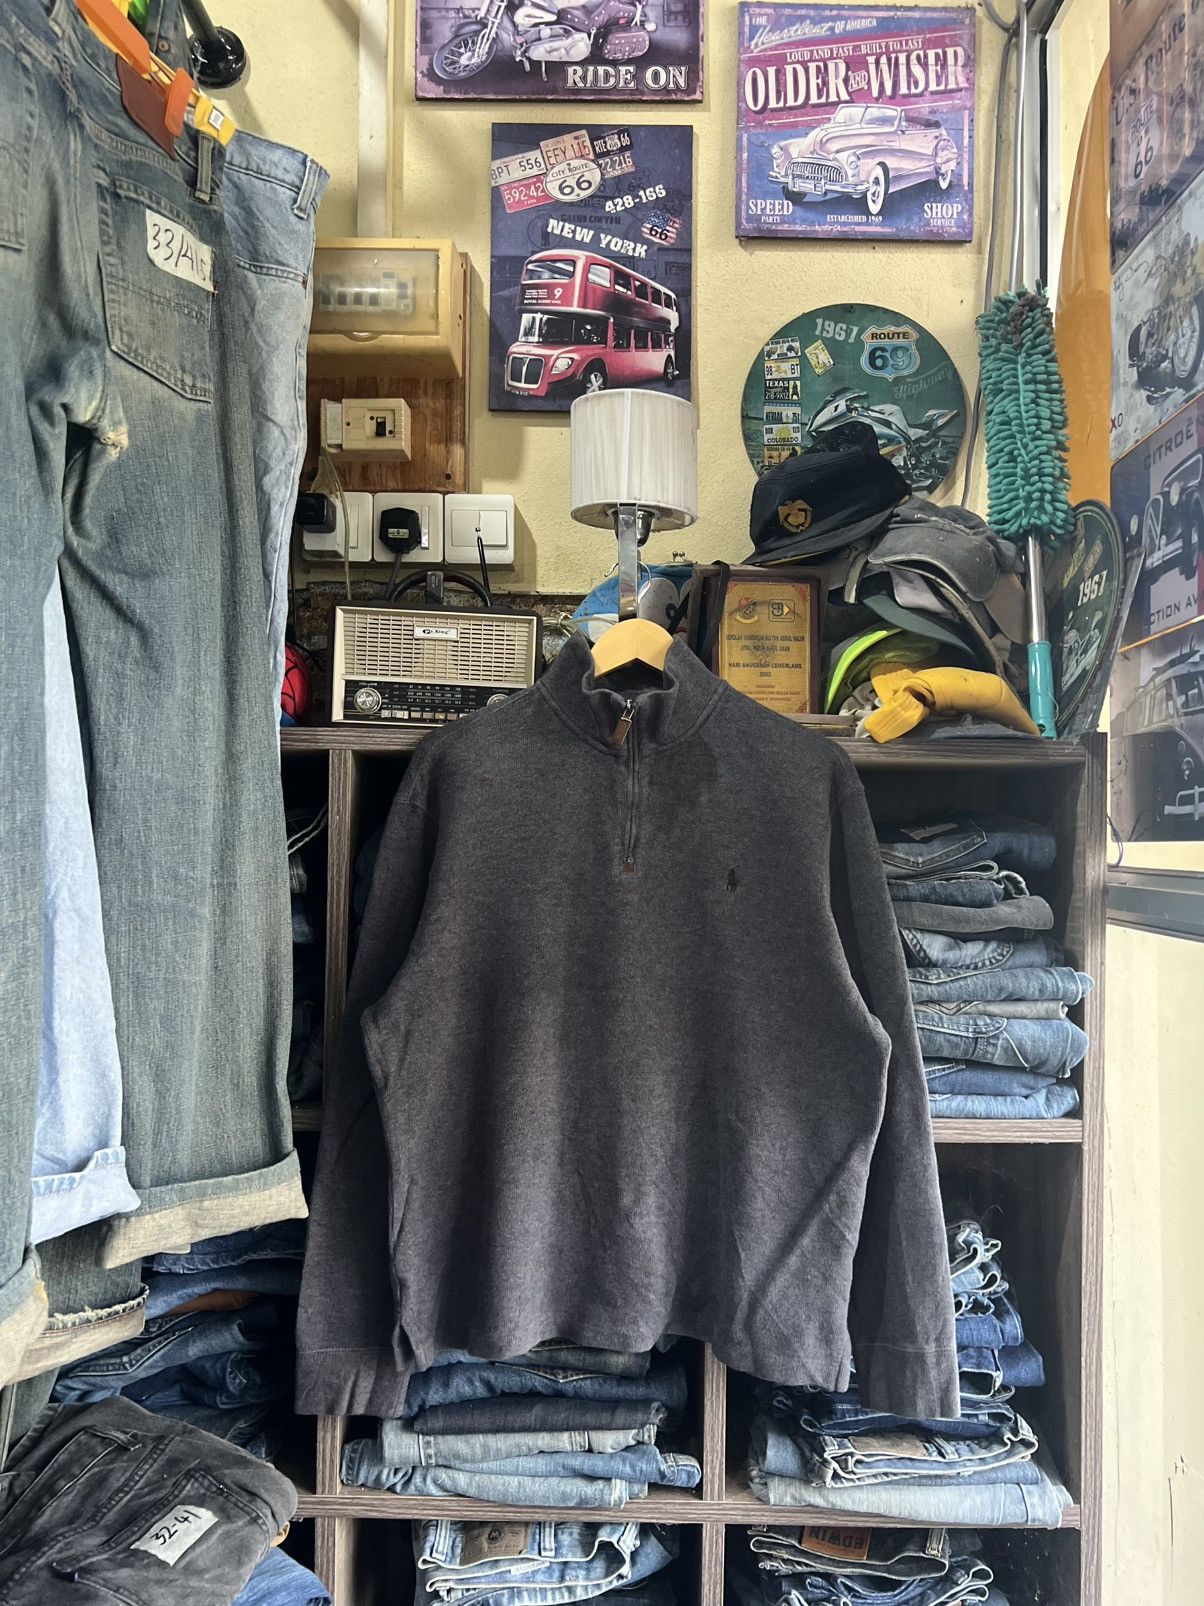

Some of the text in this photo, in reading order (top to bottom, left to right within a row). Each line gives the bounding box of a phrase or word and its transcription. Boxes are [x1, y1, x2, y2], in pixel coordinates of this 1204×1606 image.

[835, 21, 845, 33] OF
[846, 17, 877, 31] AMERICA
[786, 49, 810, 63] LOUD
[812, 47, 830, 60] AND
[888, 39, 901, 51] TO
[901, 38, 923, 50] LAST
[565, 65, 689, 90] RIDE ON
[744, 58, 850, 112] OLDER
[866, 45, 968, 98] WISER
[518, 157, 542, 173] 556
[613, 153, 633, 170] 216
[1133, 142, 1155, 180] 66
[558, 173, 593, 197] 66
[605, 183, 667, 214] 428-166
[748, 199, 962, 219] SPEED SHOP
[826, 214, 867, 223] ESTABLISHED
[546, 218, 649, 259] NEW YORK
[649, 224, 670, 241] 66
[553, 287, 563, 300] 9
[815, 318, 859, 343] 1967
[870, 331, 910, 341] ROUTE
[868, 345, 912, 371] 69
[766, 436, 799, 444] COLORADO
[1077, 569, 1108, 608] 1967
[150, 1509, 202, 1546] 32-41
